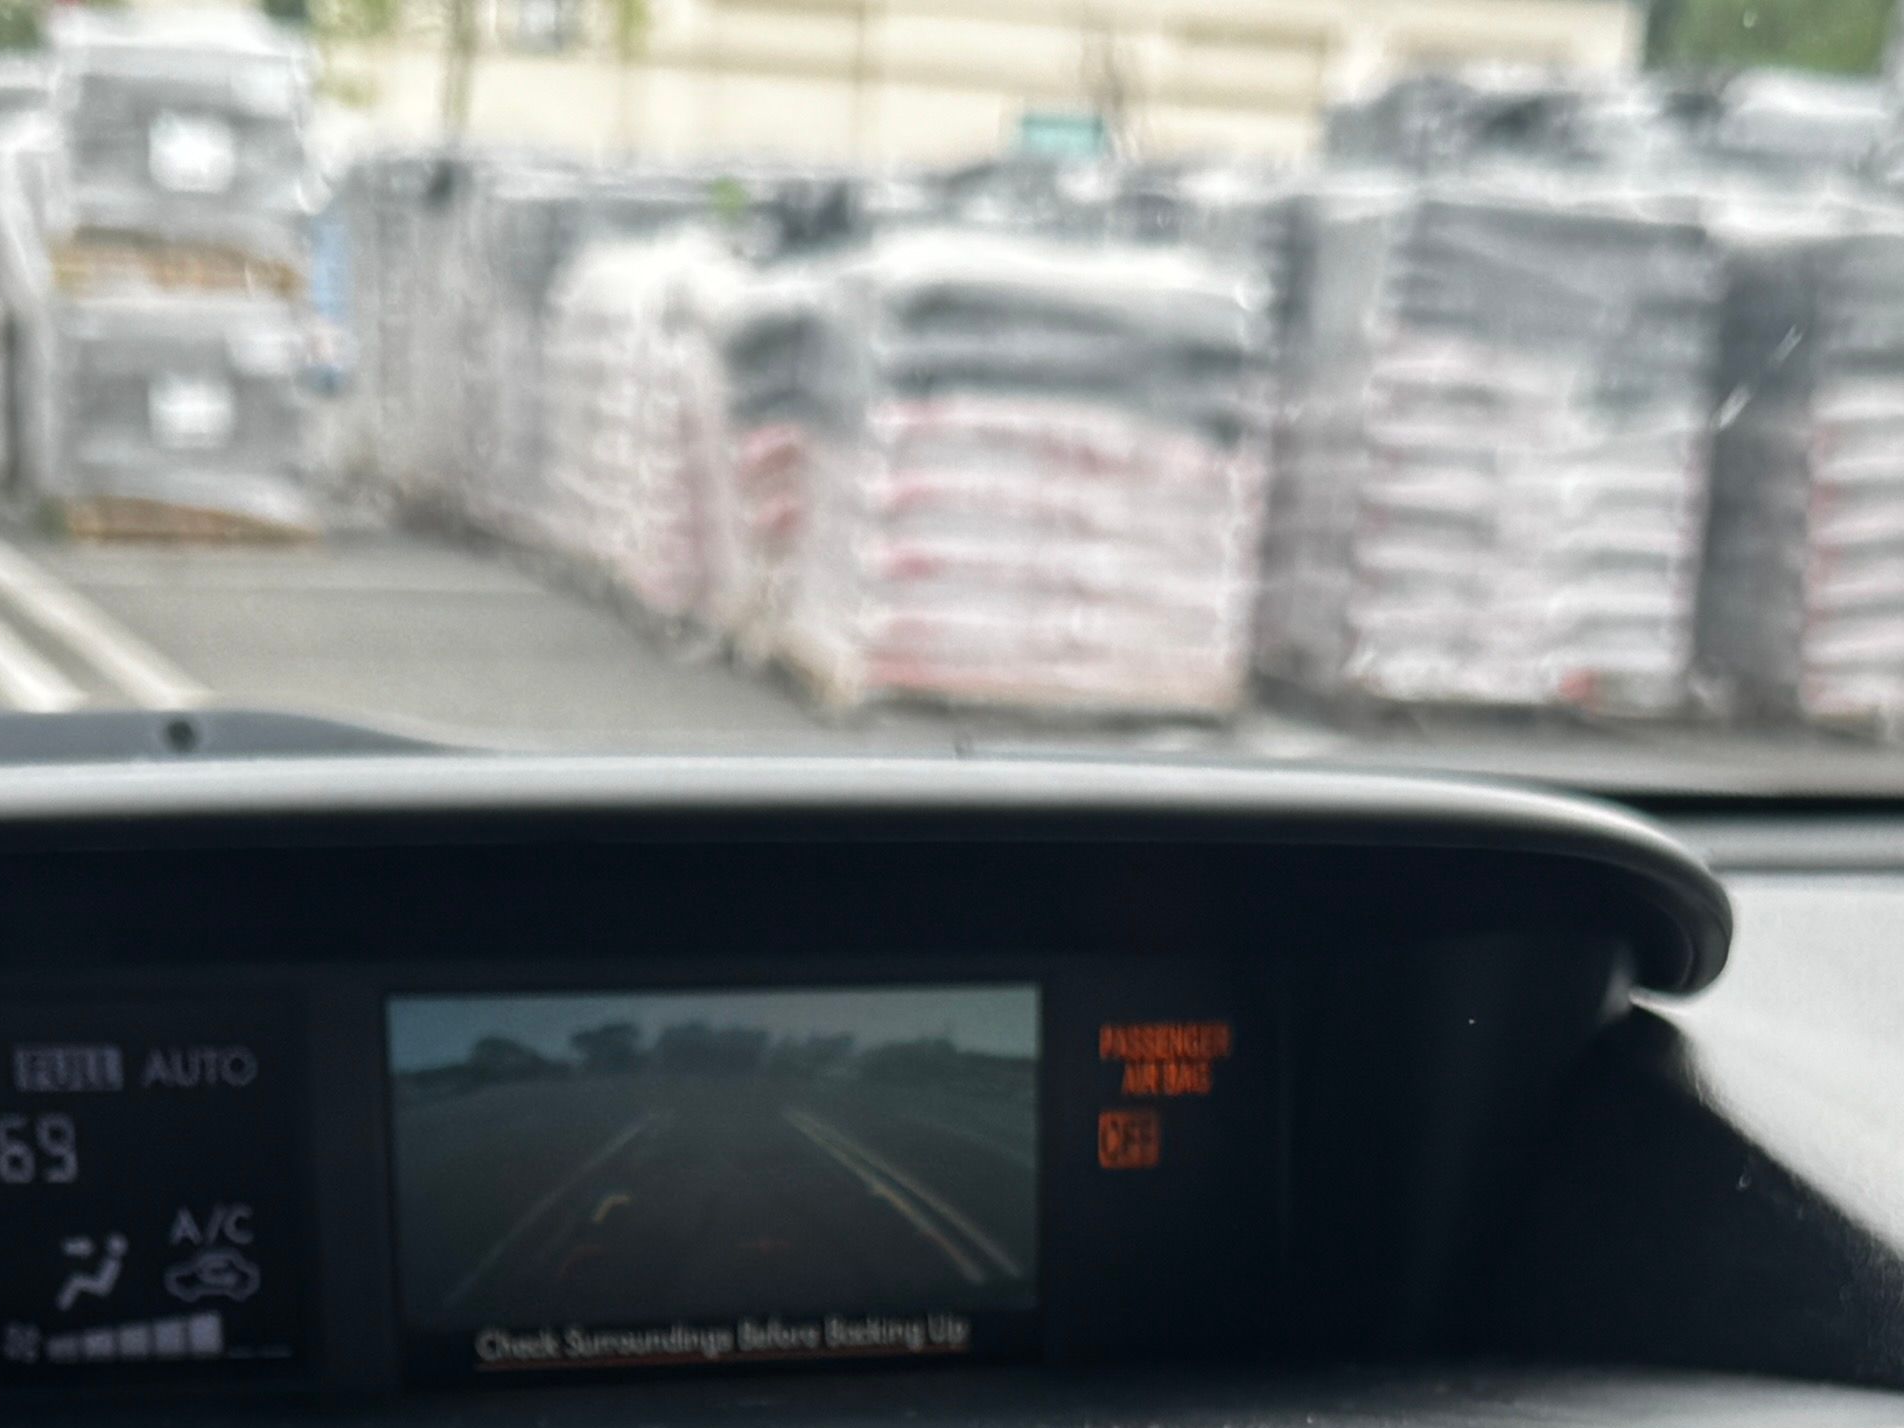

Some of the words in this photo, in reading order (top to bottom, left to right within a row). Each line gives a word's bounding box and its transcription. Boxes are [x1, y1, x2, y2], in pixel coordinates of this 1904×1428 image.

[1099, 1022, 1234, 1060] PASSENGER
[140, 1045, 259, 1089] AUTO
[170, 1202, 256, 1246] A/C
[474, 1326, 560, 1361] Check
[565, 1322, 734, 1360] Surroundings
